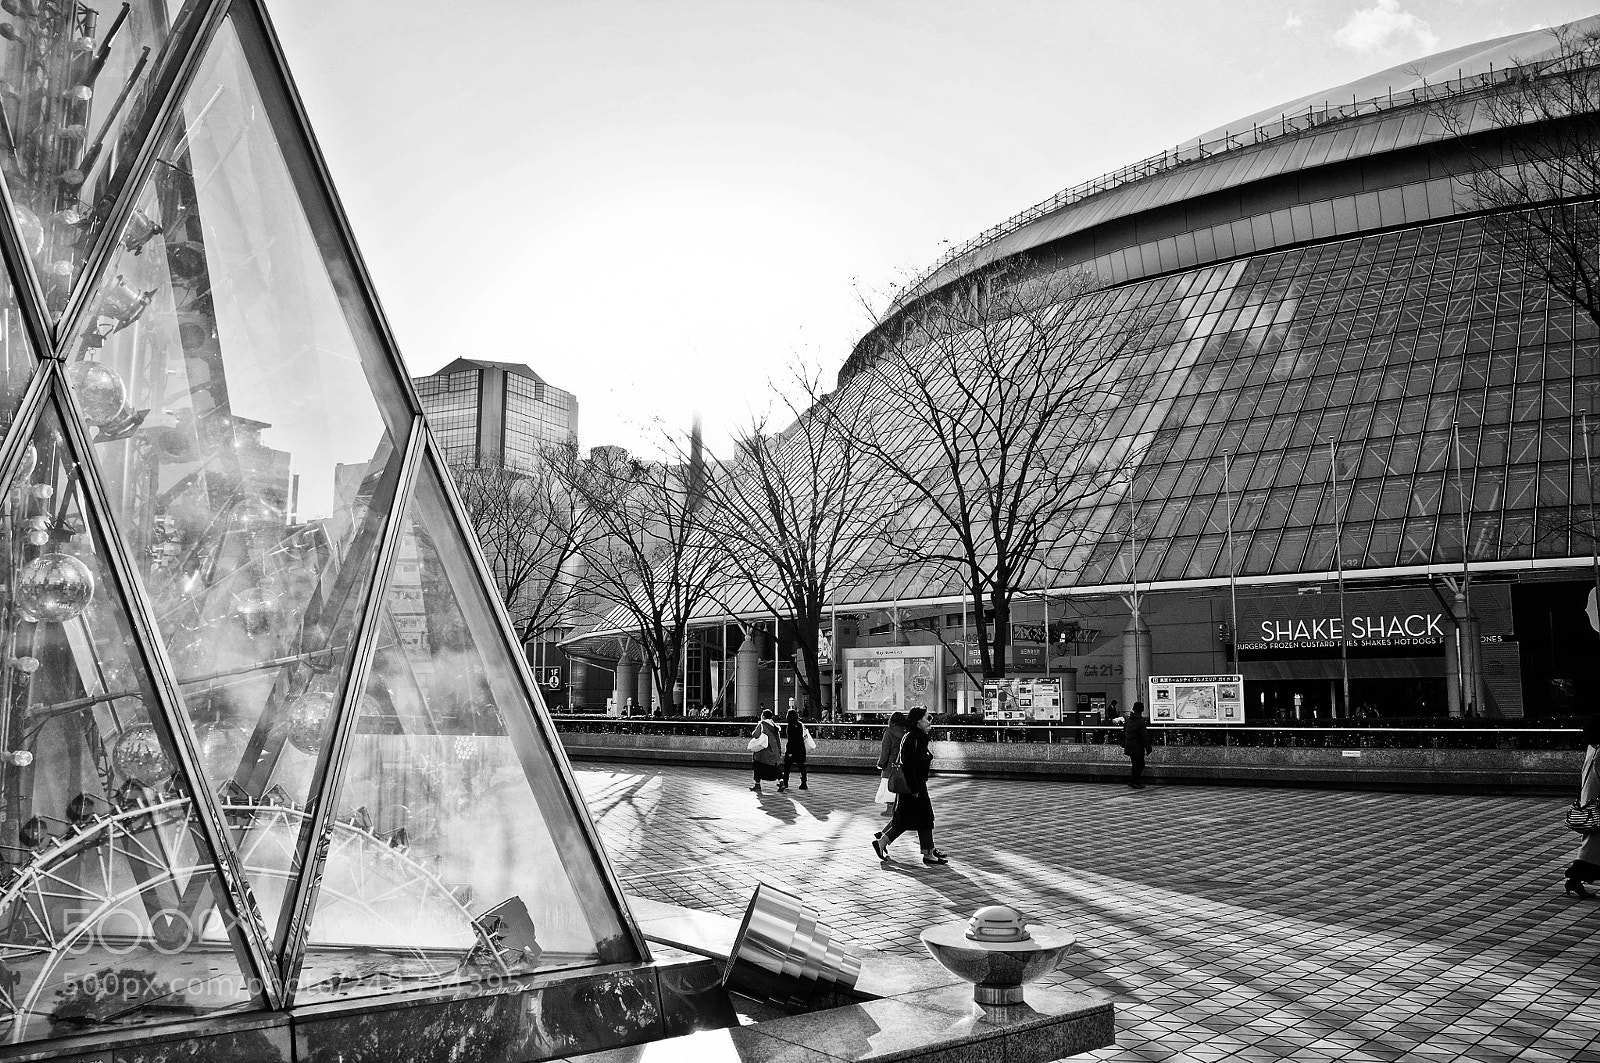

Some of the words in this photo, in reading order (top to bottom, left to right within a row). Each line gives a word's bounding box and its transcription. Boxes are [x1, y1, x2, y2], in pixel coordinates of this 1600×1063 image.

[1261, 618, 1343, 641] SHAKE
[1351, 613, 1444, 638] SHACK
[1269, 641, 1299, 649] FROZEN
[1337, 640, 1358, 648] FIES
[1361, 639, 1391, 647] SHAKES
[1394, 638, 1411, 646] HOT
[1412, 637, 1437, 645] DOGS
[1480, 635, 1502, 643] ONES
[1099, 664, 1113, 676] 21
